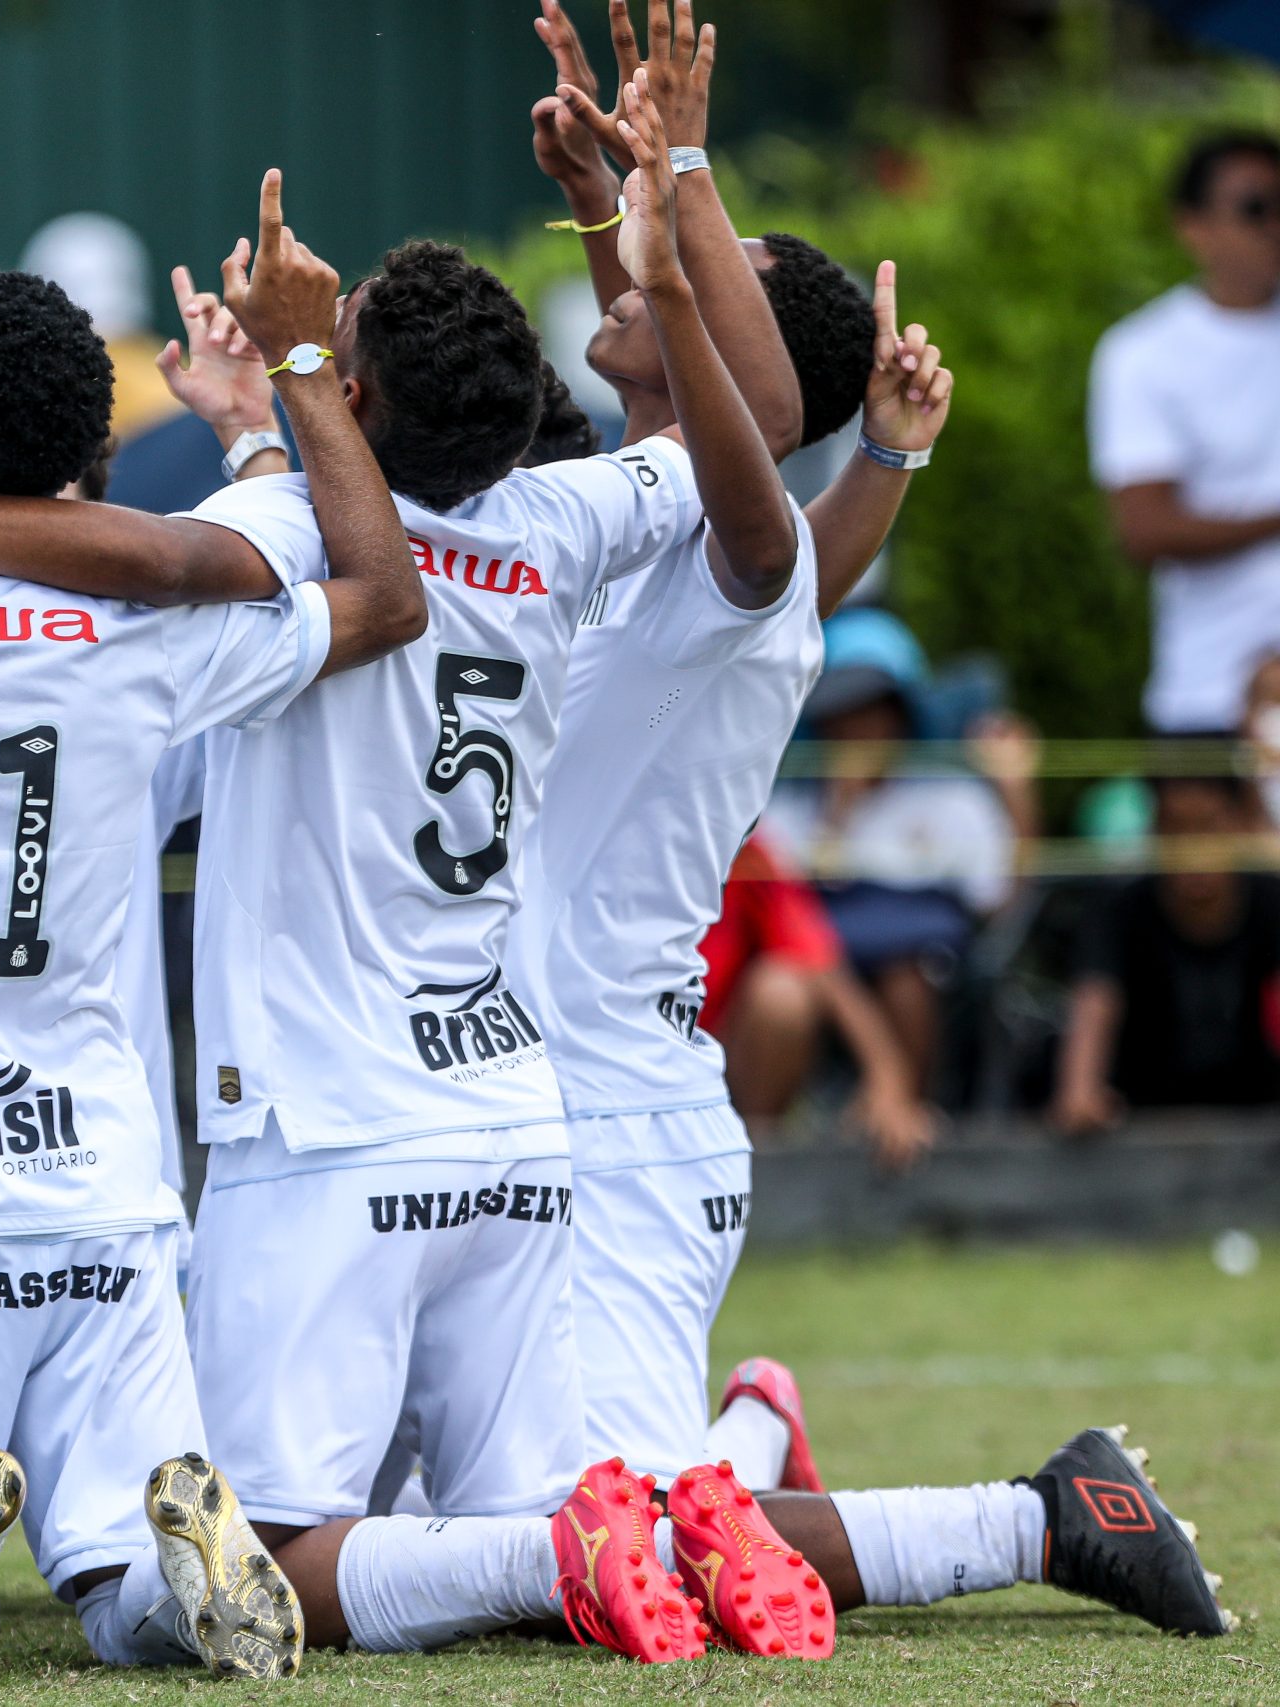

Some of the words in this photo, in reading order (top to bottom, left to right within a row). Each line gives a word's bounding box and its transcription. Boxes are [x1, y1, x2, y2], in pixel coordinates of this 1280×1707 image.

[407, 535, 549, 597] aiwa
[413, 652, 526, 896] 5
[13, 799, 49, 919] LOOVI
[409, 989, 542, 1072] Brasil
